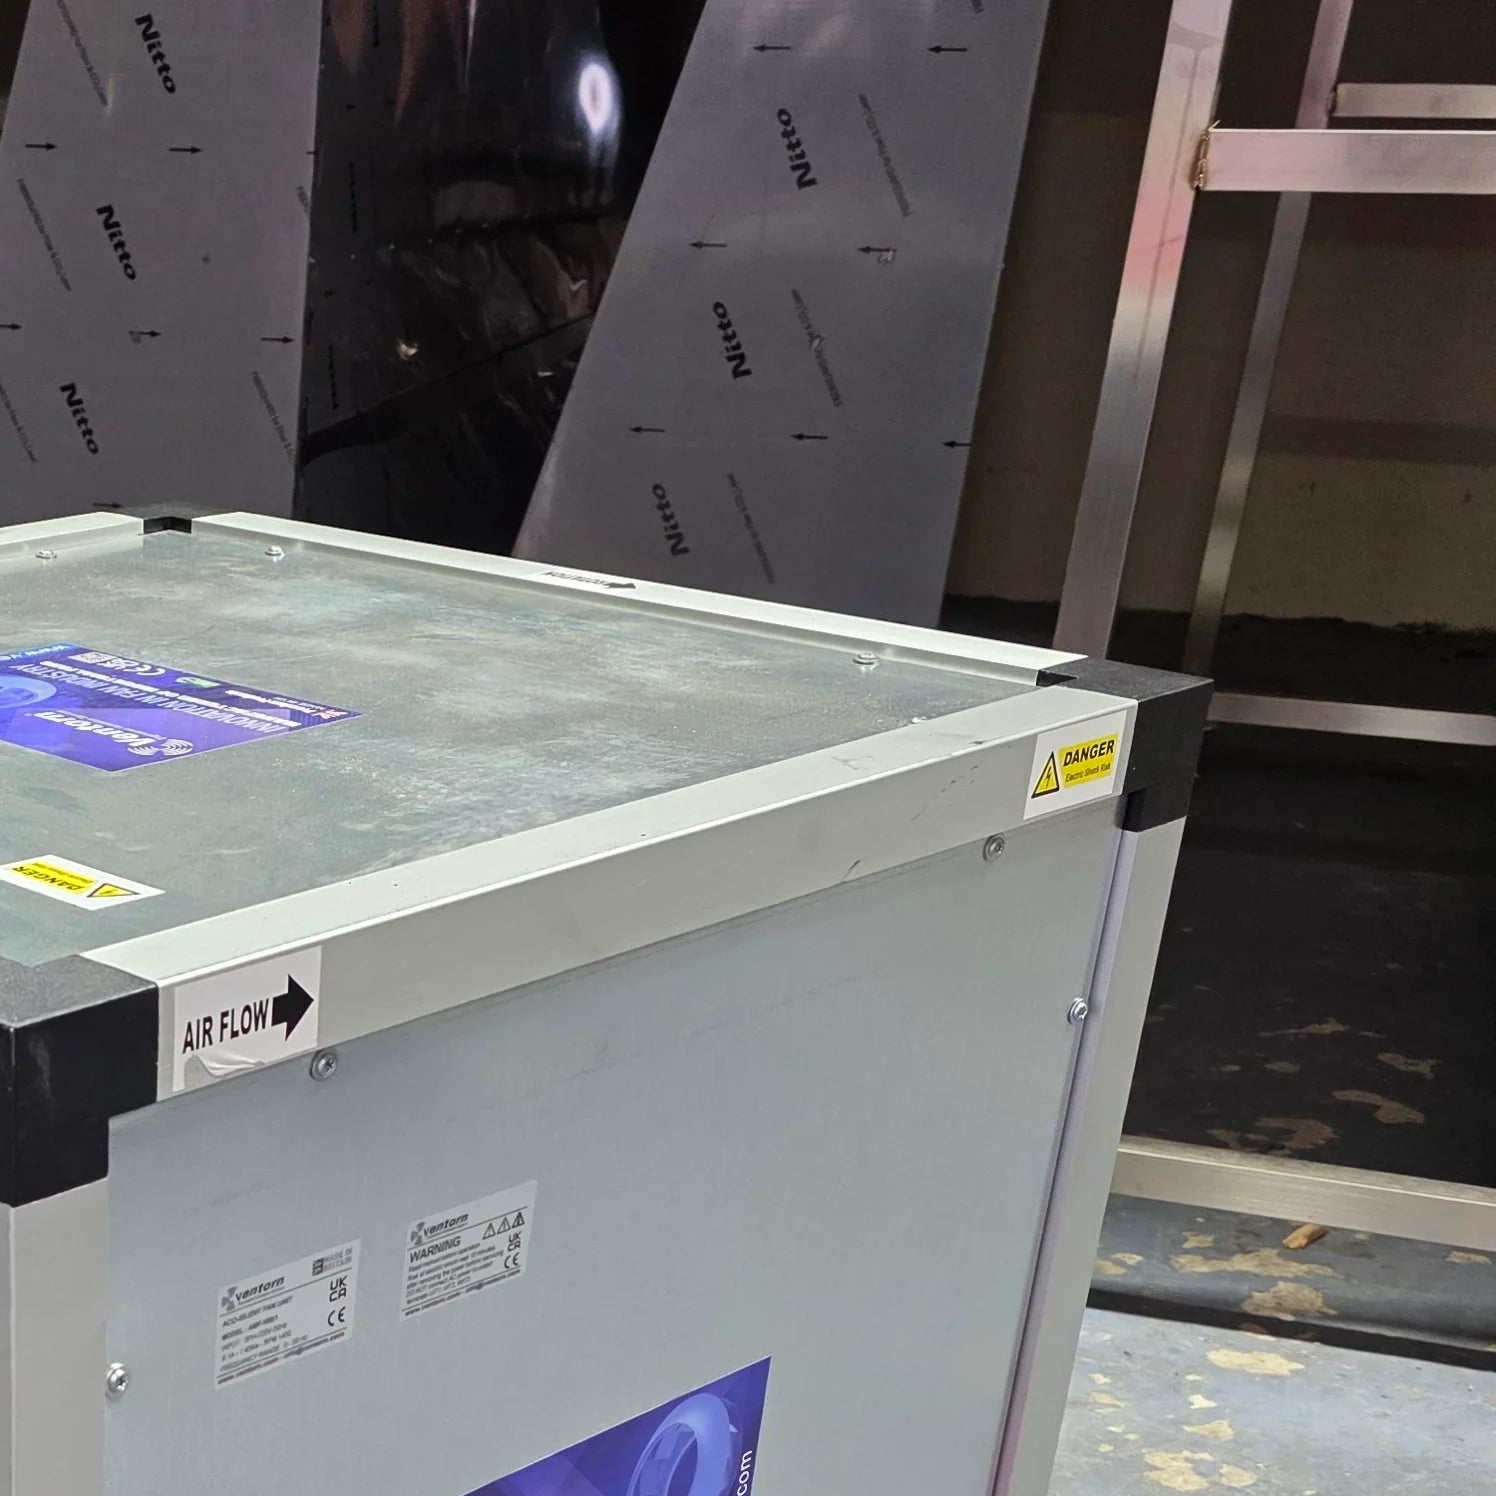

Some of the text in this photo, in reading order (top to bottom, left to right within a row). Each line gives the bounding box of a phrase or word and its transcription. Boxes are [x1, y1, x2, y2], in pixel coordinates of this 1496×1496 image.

[135, 12, 176, 94] Nitto
[777, 108, 818, 190] Nitto
[96, 204, 136, 280] Nitto
[712, 302, 752, 379] Nitto
[59, 382, 99, 454] Nitto
[652, 484, 690, 557] Nitto
[8, 663, 110, 689] INDUSTRY
[34, 711, 156, 747] Ventorn
[157, 700, 287, 733] INNOVATION
[1063, 739, 1115, 767] DANGER
[12, 865, 85, 891] DANGER
[182, 998, 269, 1054] AIR FLOW
[409, 1236, 461, 1263] WARNING
[329, 1288, 347, 1302] CA
[330, 1275, 348, 1291] UK
[327, 1306, 346, 1327] CE
